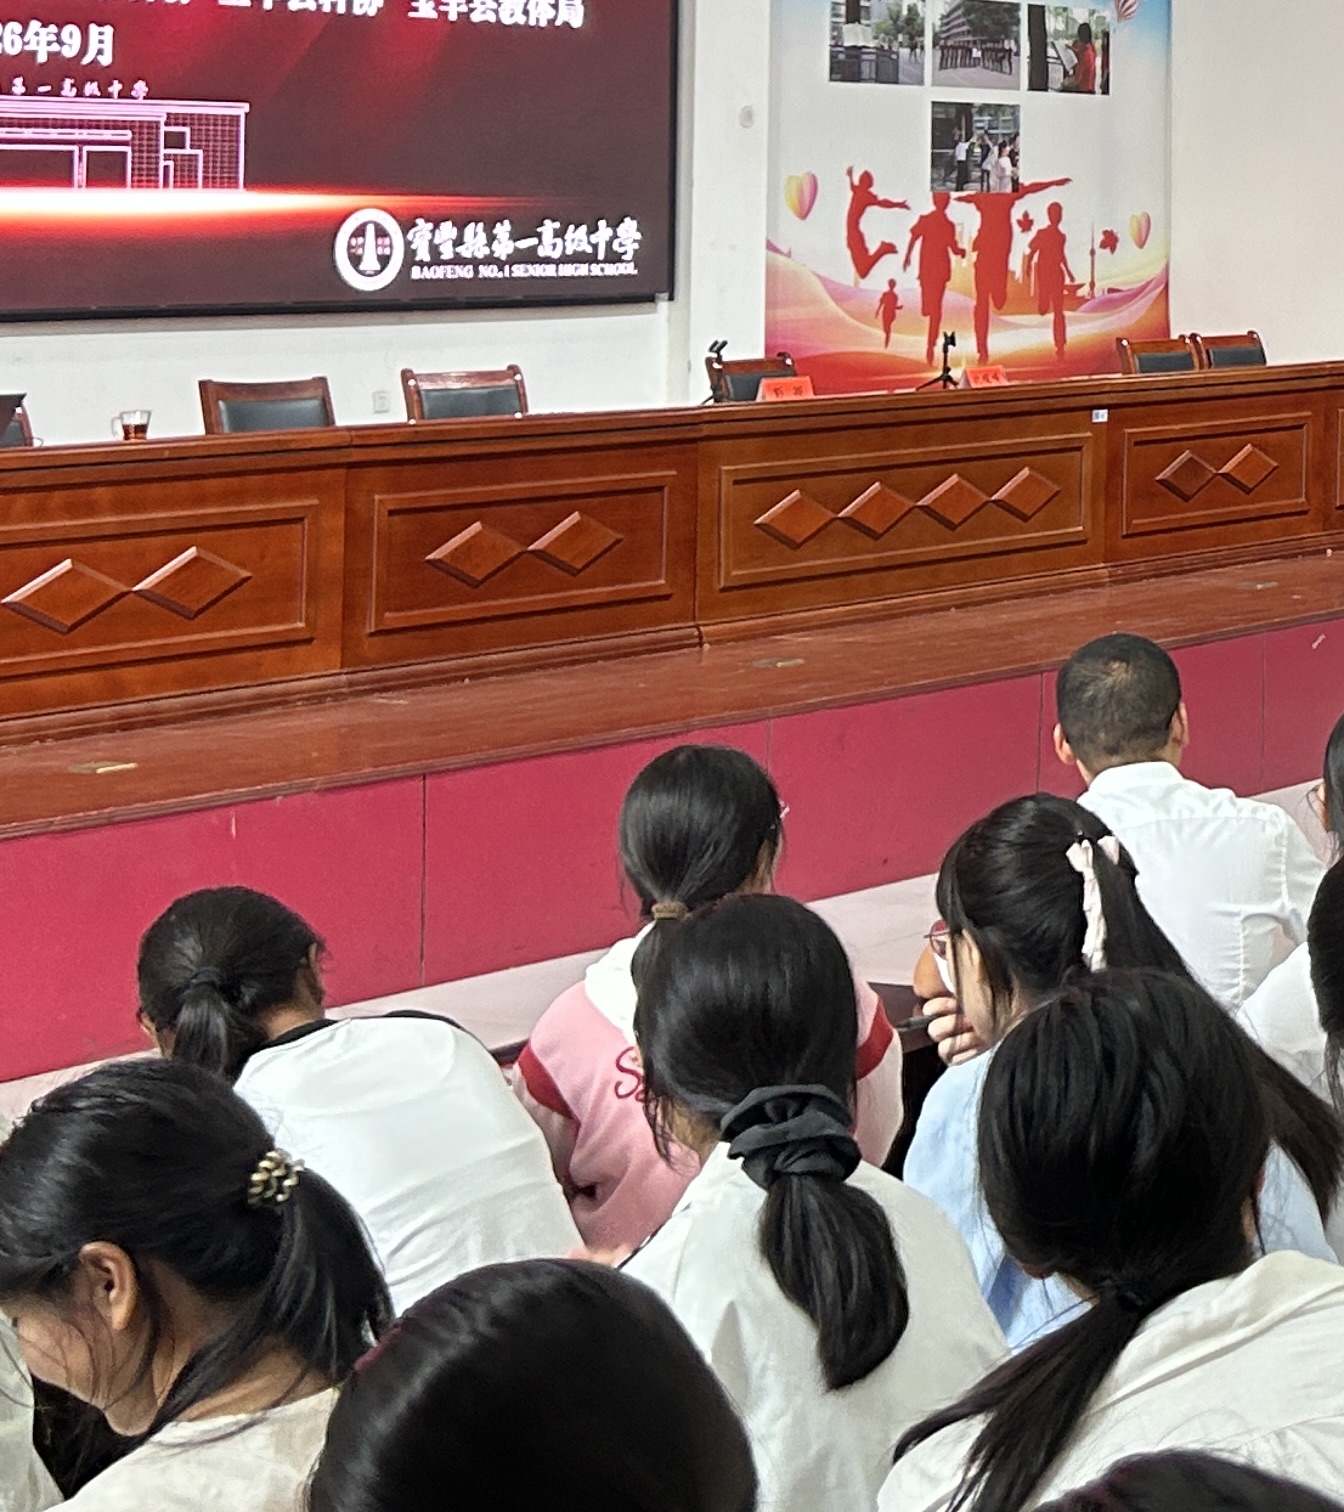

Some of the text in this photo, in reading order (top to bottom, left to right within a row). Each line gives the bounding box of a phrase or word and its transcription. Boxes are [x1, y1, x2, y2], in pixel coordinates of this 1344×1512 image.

[0, 19, 114, 67] 6年9月
[411, 264, 475, 280] BAOFENG
[511, 263, 556, 278] SENIOR
[557, 262, 589, 277] HIGH
[589, 261, 639, 276] SCHOOL
